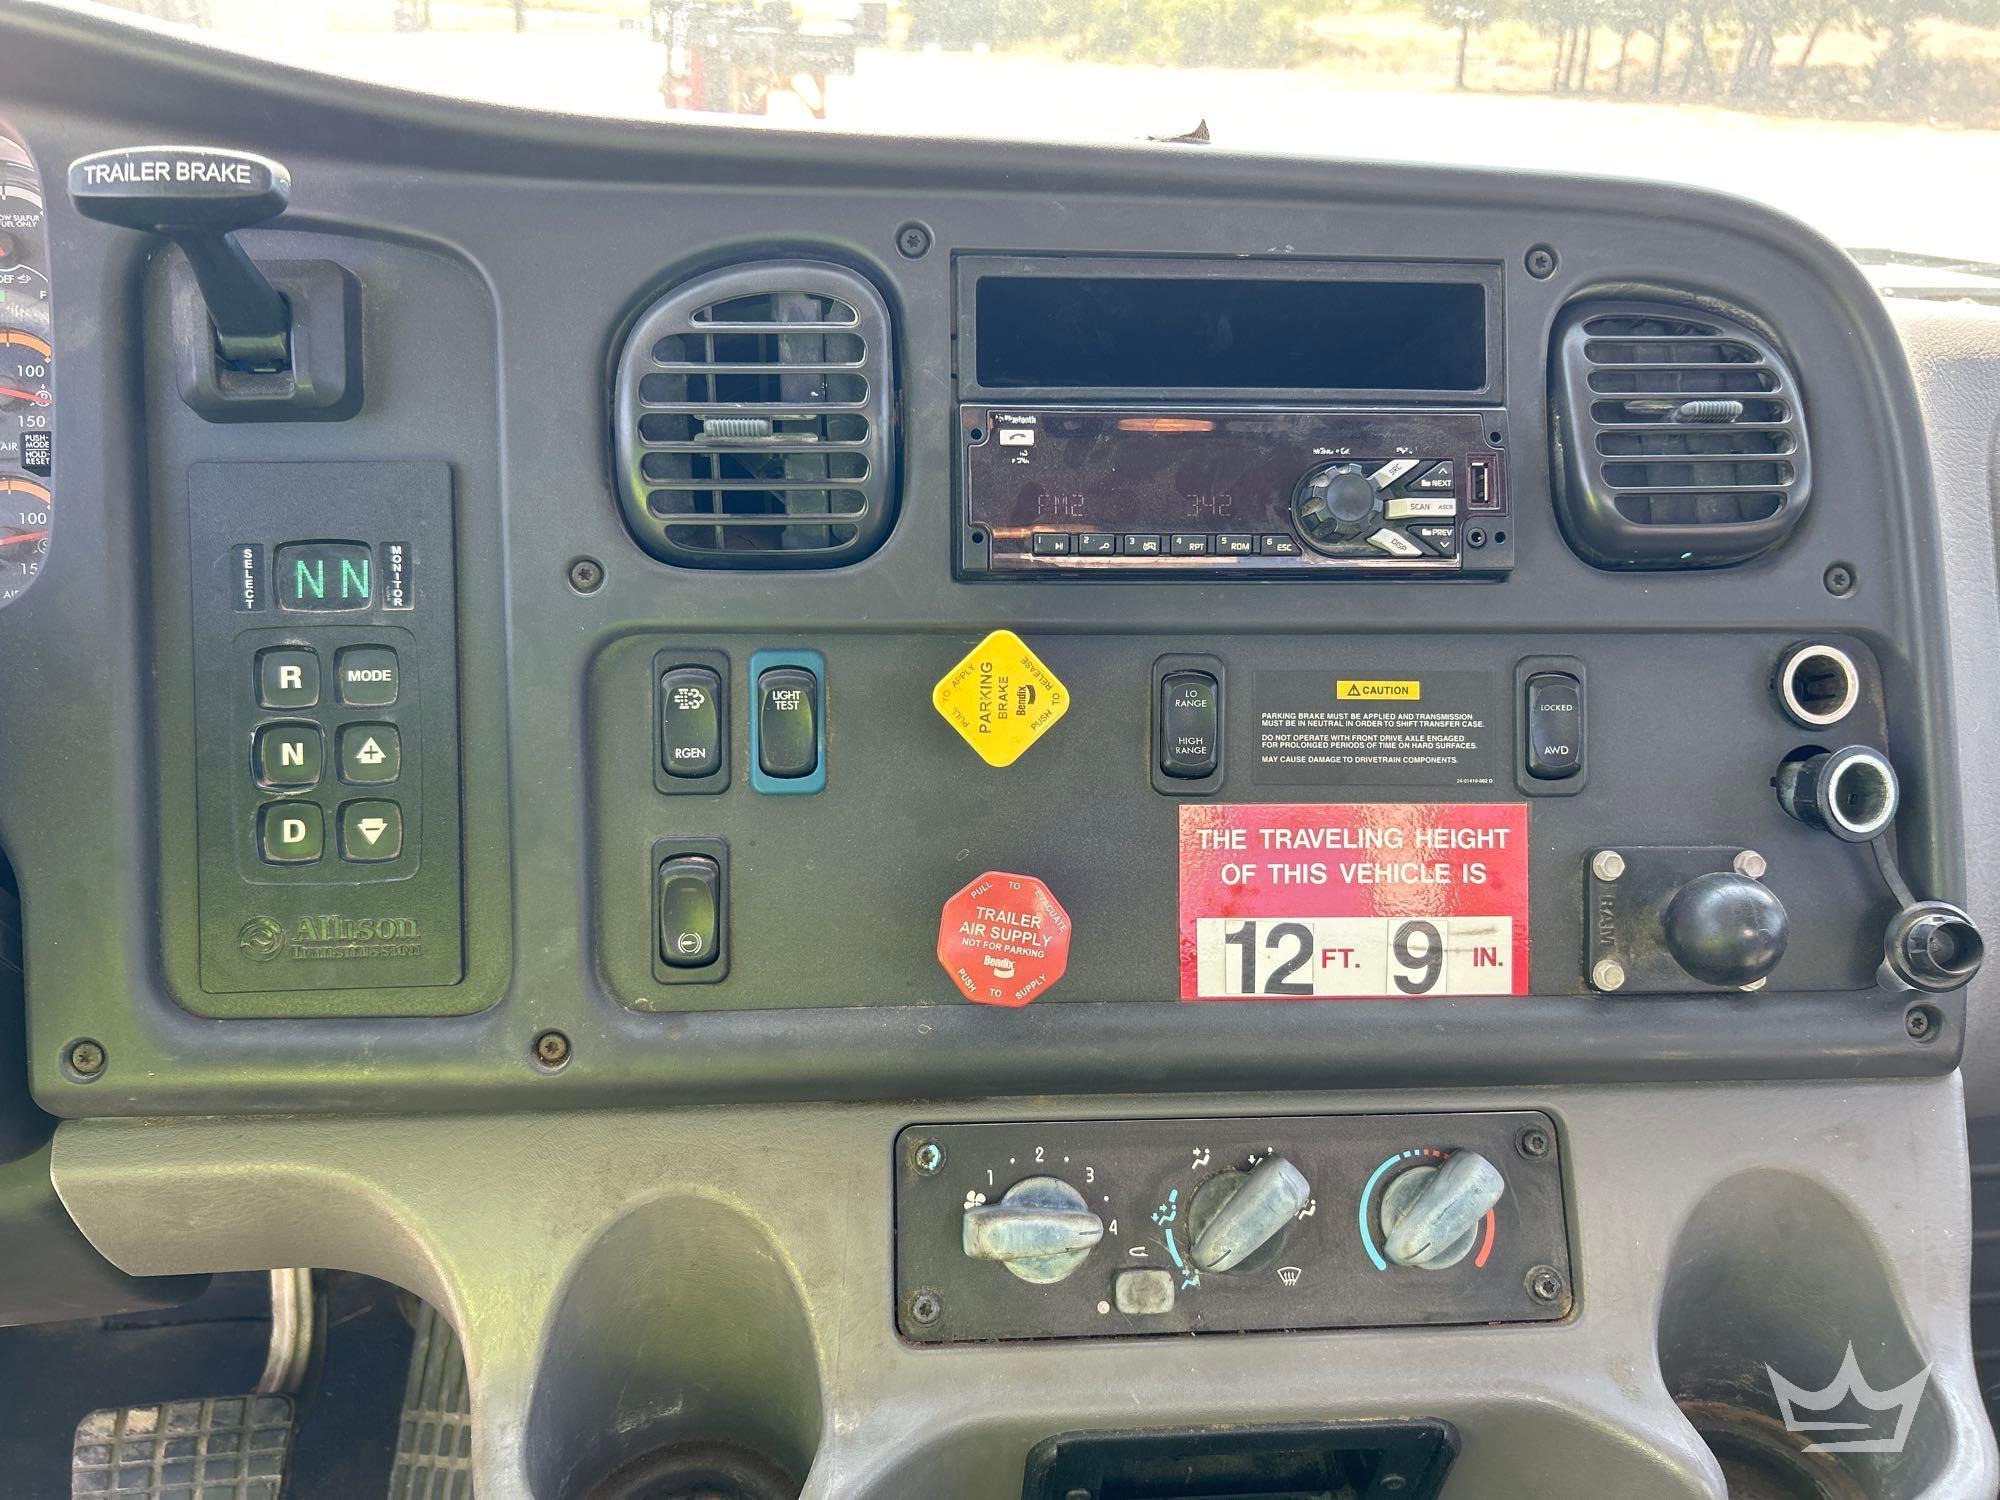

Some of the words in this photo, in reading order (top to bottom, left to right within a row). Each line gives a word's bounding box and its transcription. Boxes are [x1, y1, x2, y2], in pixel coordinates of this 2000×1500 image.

[84, 162, 170, 184] TRAILER
[176, 161, 251, 183] BRAKE
[16, 220, 37, 228] ONLY
[40, 290, 47, 299] F
[17, 365, 45, 377] 100
[18, 415, 46, 427] 150
[0, 442, 18, 451] AIR
[25, 441, 50, 449] MODE
[1389, 463, 1403, 476] SRC
[1431, 479, 1452, 487] NEXT
[20, 512, 47, 525] 100
[1189, 543, 1204, 551] RPT
[1391, 538, 1407, 551] DISP
[243, 548, 255, 610] SELECT
[297, 560, 324, 599] N
[342, 559, 369, 598] N
[390, 545, 403, 607] MONITOR
[280, 665, 302, 689] R
[348, 669, 392, 682] MODE
[952, 663, 975, 688] APPLY
[1020, 656, 1053, 691] RELEASE
[772, 690, 801, 700] LIGHT
[979, 661, 993, 734] PARKING
[998, 675, 1009, 720] BRAKE
[1185, 690, 1198, 698] LO
[1362, 686, 1409, 695] CAUTION
[775, 700, 800, 710] TEST
[1016, 685, 1026, 716] Bendix
[1052, 692, 1060, 706] TO
[1175, 699, 1207, 708] RANGE
[1540, 704, 1573, 712] LOCKED
[952, 707, 970, 728] PULL
[1030, 709, 1053, 731] PUSH
[1262, 712, 1296, 720] PARKING
[1298, 712, 1325, 720] BRAKE
[1327, 712, 1348, 720] MUST
[1350, 712, 1361, 720] BE
[1363, 712, 1395, 720] APPLIED
[1398, 713, 1414, 721] AND
[1416, 713, 1472, 721] TRANSMISSION
[1178, 737, 1203, 745] HIGH
[281, 742, 304, 766] N
[675, 748, 706, 759] RGEN
[1175, 746, 1207, 755] RANGE
[1544, 745, 1569, 755] AWD
[283, 819, 306, 843] D
[1199, 828, 1247, 850] THE
[1259, 828, 1403, 849] TRAVELING
[1415, 828, 1510, 849] HEIGHT
[1221, 863, 1257, 885] OF
[1268, 863, 1327, 884] THIS
[1339, 863, 1451, 884] VEHICLE
[1463, 863, 1487, 884] IS
[970, 881, 992, 899] PULL
[1008, 880, 1021, 890] TO
[1034, 888, 1068, 933] EVACUATE
[976, 906, 1042, 929] TRAILER
[292, 914, 421, 941] Allison
[959, 921, 986, 937] AIR
[990, 926, 1052, 948] SUPPLY
[961, 937, 980, 948] NOT
[983, 941, 1002, 951] FOR
[1004, 944, 1045, 959] PARKING
[983, 955, 1015, 970] Bendix
[1225, 920, 1314, 995] 12
[1321, 948, 1360, 969] FT.
[1392, 919, 1443, 995] 9
[1473, 947, 1503, 967] IN.
[957, 968, 977, 993] PUSH
[989, 988, 1002, 997] TO
[1015, 973, 1047, 1000] SUPPLY
[1035, 1146, 1045, 1163] 2
[986, 1169, 993, 1185] 1
[1085, 1167, 1095, 1183] 3
[1108, 1219, 1118, 1236] 4
